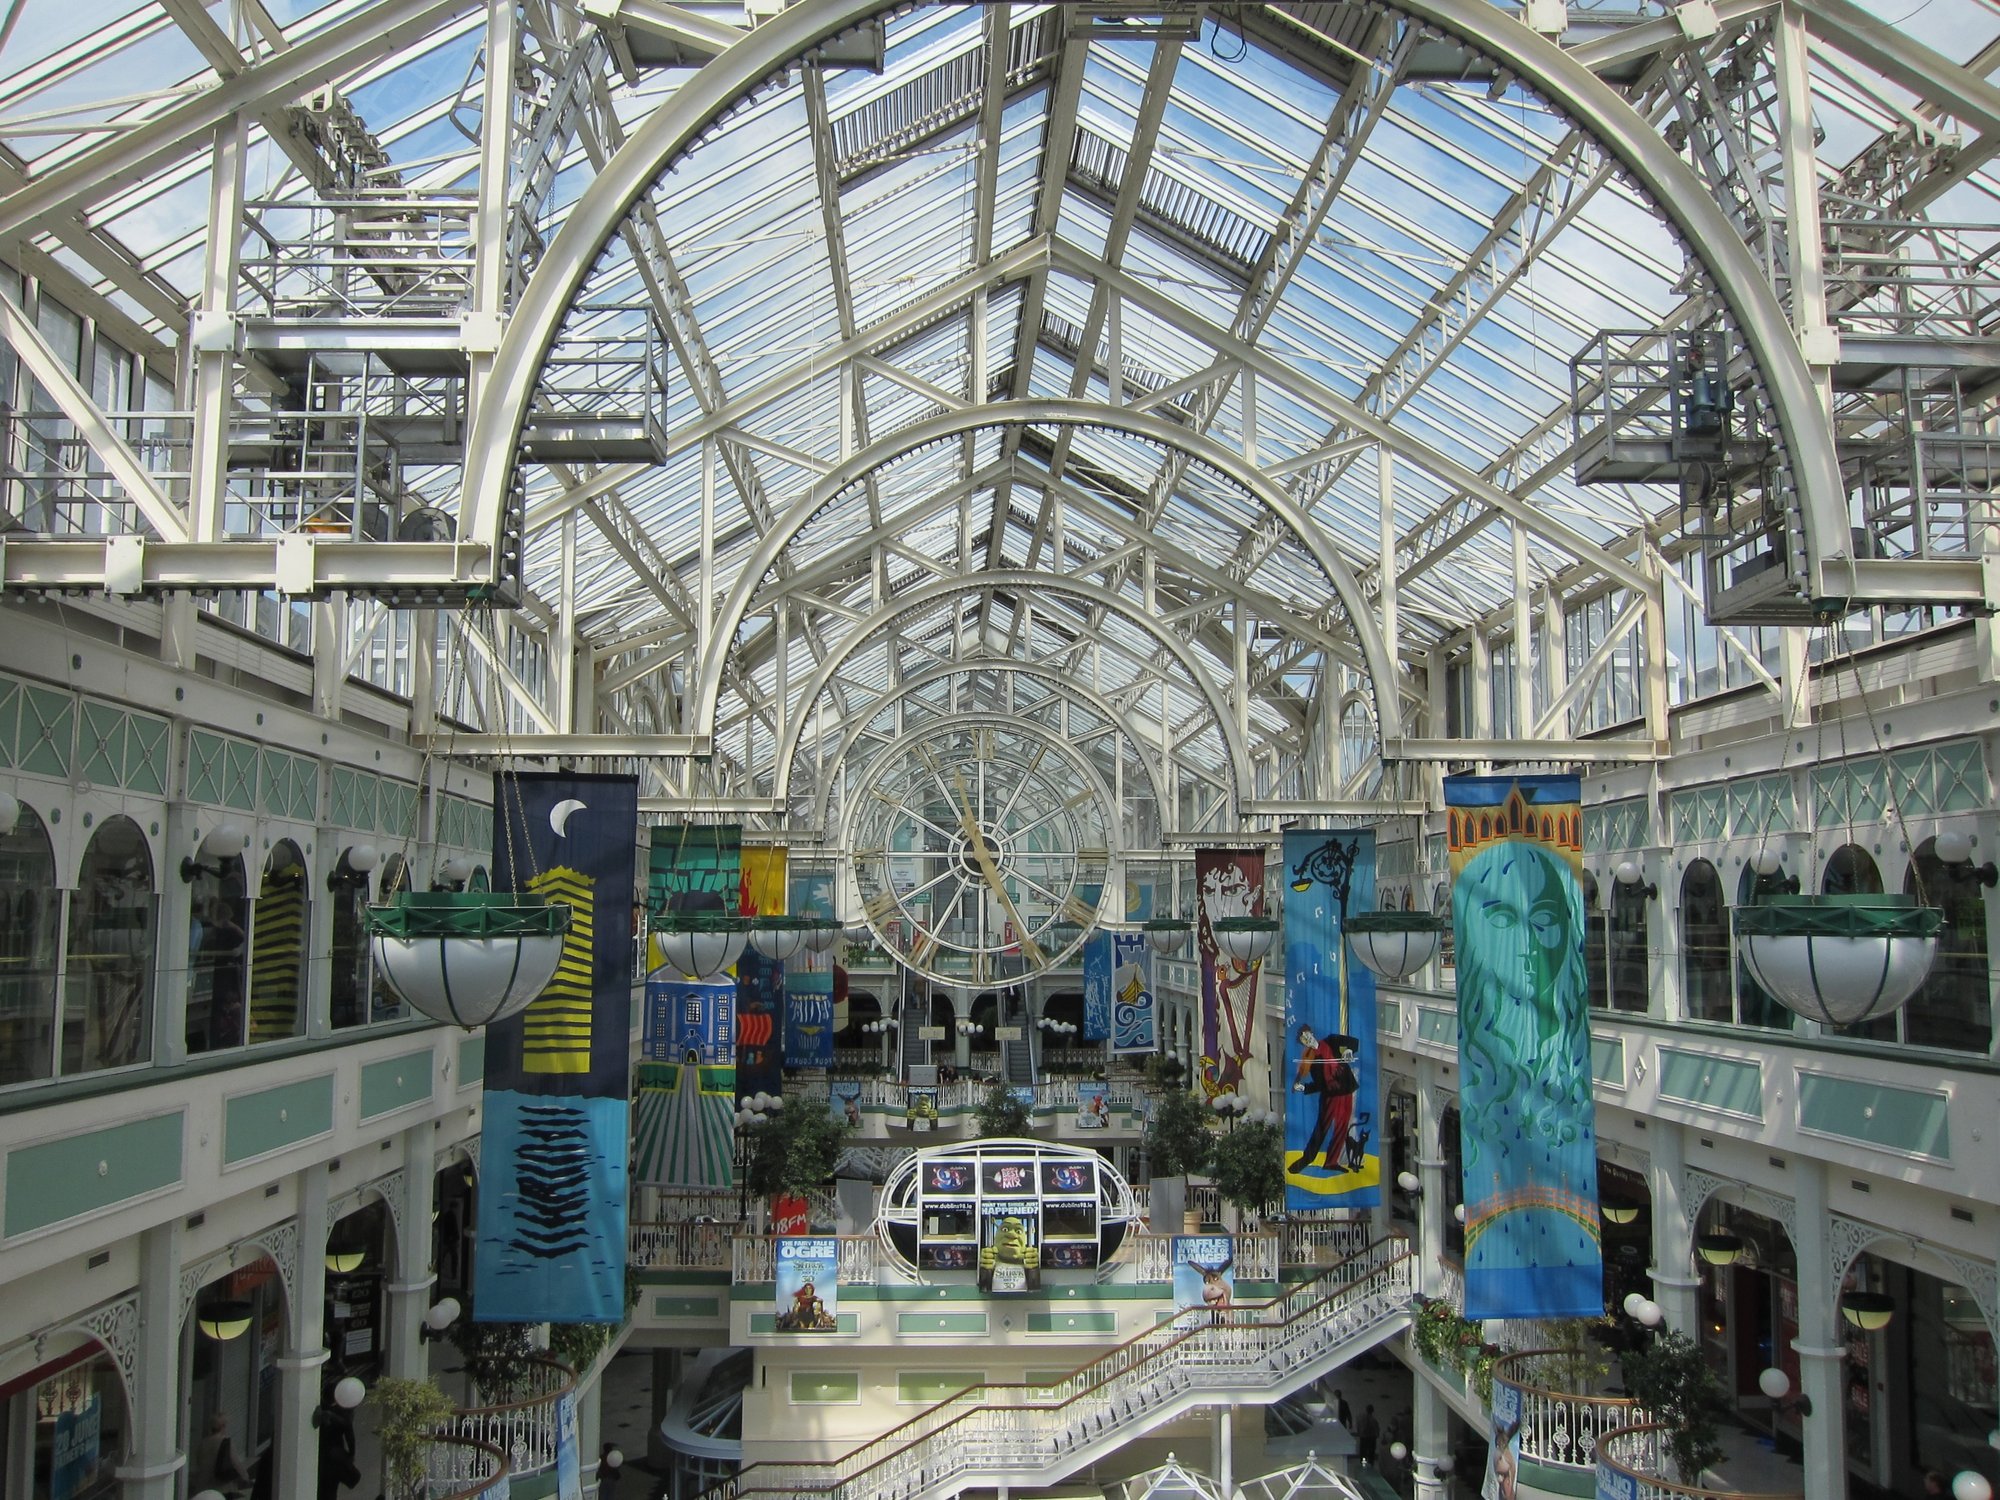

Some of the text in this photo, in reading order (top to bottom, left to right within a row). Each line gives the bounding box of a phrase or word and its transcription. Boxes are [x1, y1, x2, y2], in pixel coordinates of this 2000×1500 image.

[1002, 1179, 1022, 1188] MIX
[981, 1206, 1039, 1215] HAPPENED?
[1177, 1239, 1229, 1248] WAFFLES
[781, 1246, 835, 1258] OGRE
[1177, 1253, 1230, 1264] DANGER
